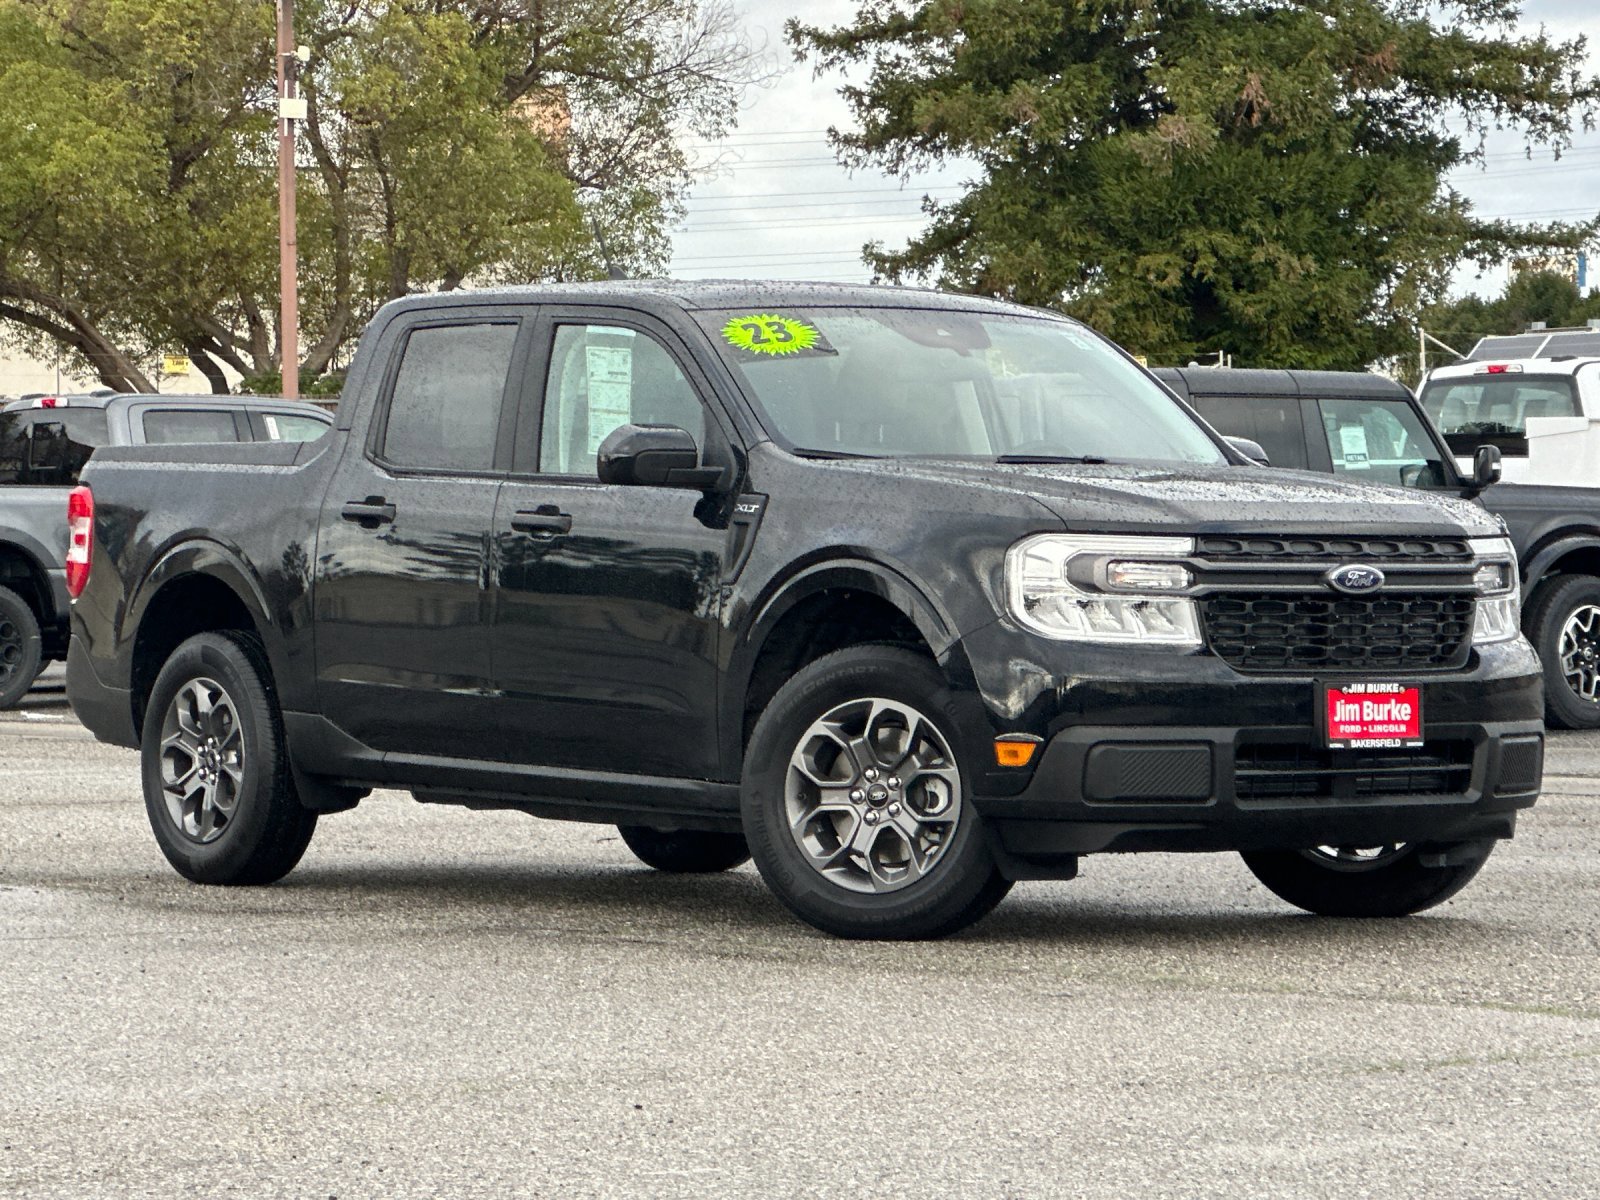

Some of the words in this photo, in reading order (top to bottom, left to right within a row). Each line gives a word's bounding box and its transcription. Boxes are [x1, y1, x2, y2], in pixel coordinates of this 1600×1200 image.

[740, 321, 794, 344] 23
[734, 503, 760, 513] XLT
[1345, 570, 1374, 587] Ford
[1348, 683, 1365, 693] JIM
[1366, 683, 1399, 693] BURKE
[1333, 699, 1360, 722] Jim
[1362, 698, 1412, 721] Burke
[1339, 724, 1362, 733] FORD
[1368, 724, 1407, 733] LINCOLN
[1350, 739, 1401, 748] BAKERSFIELD
